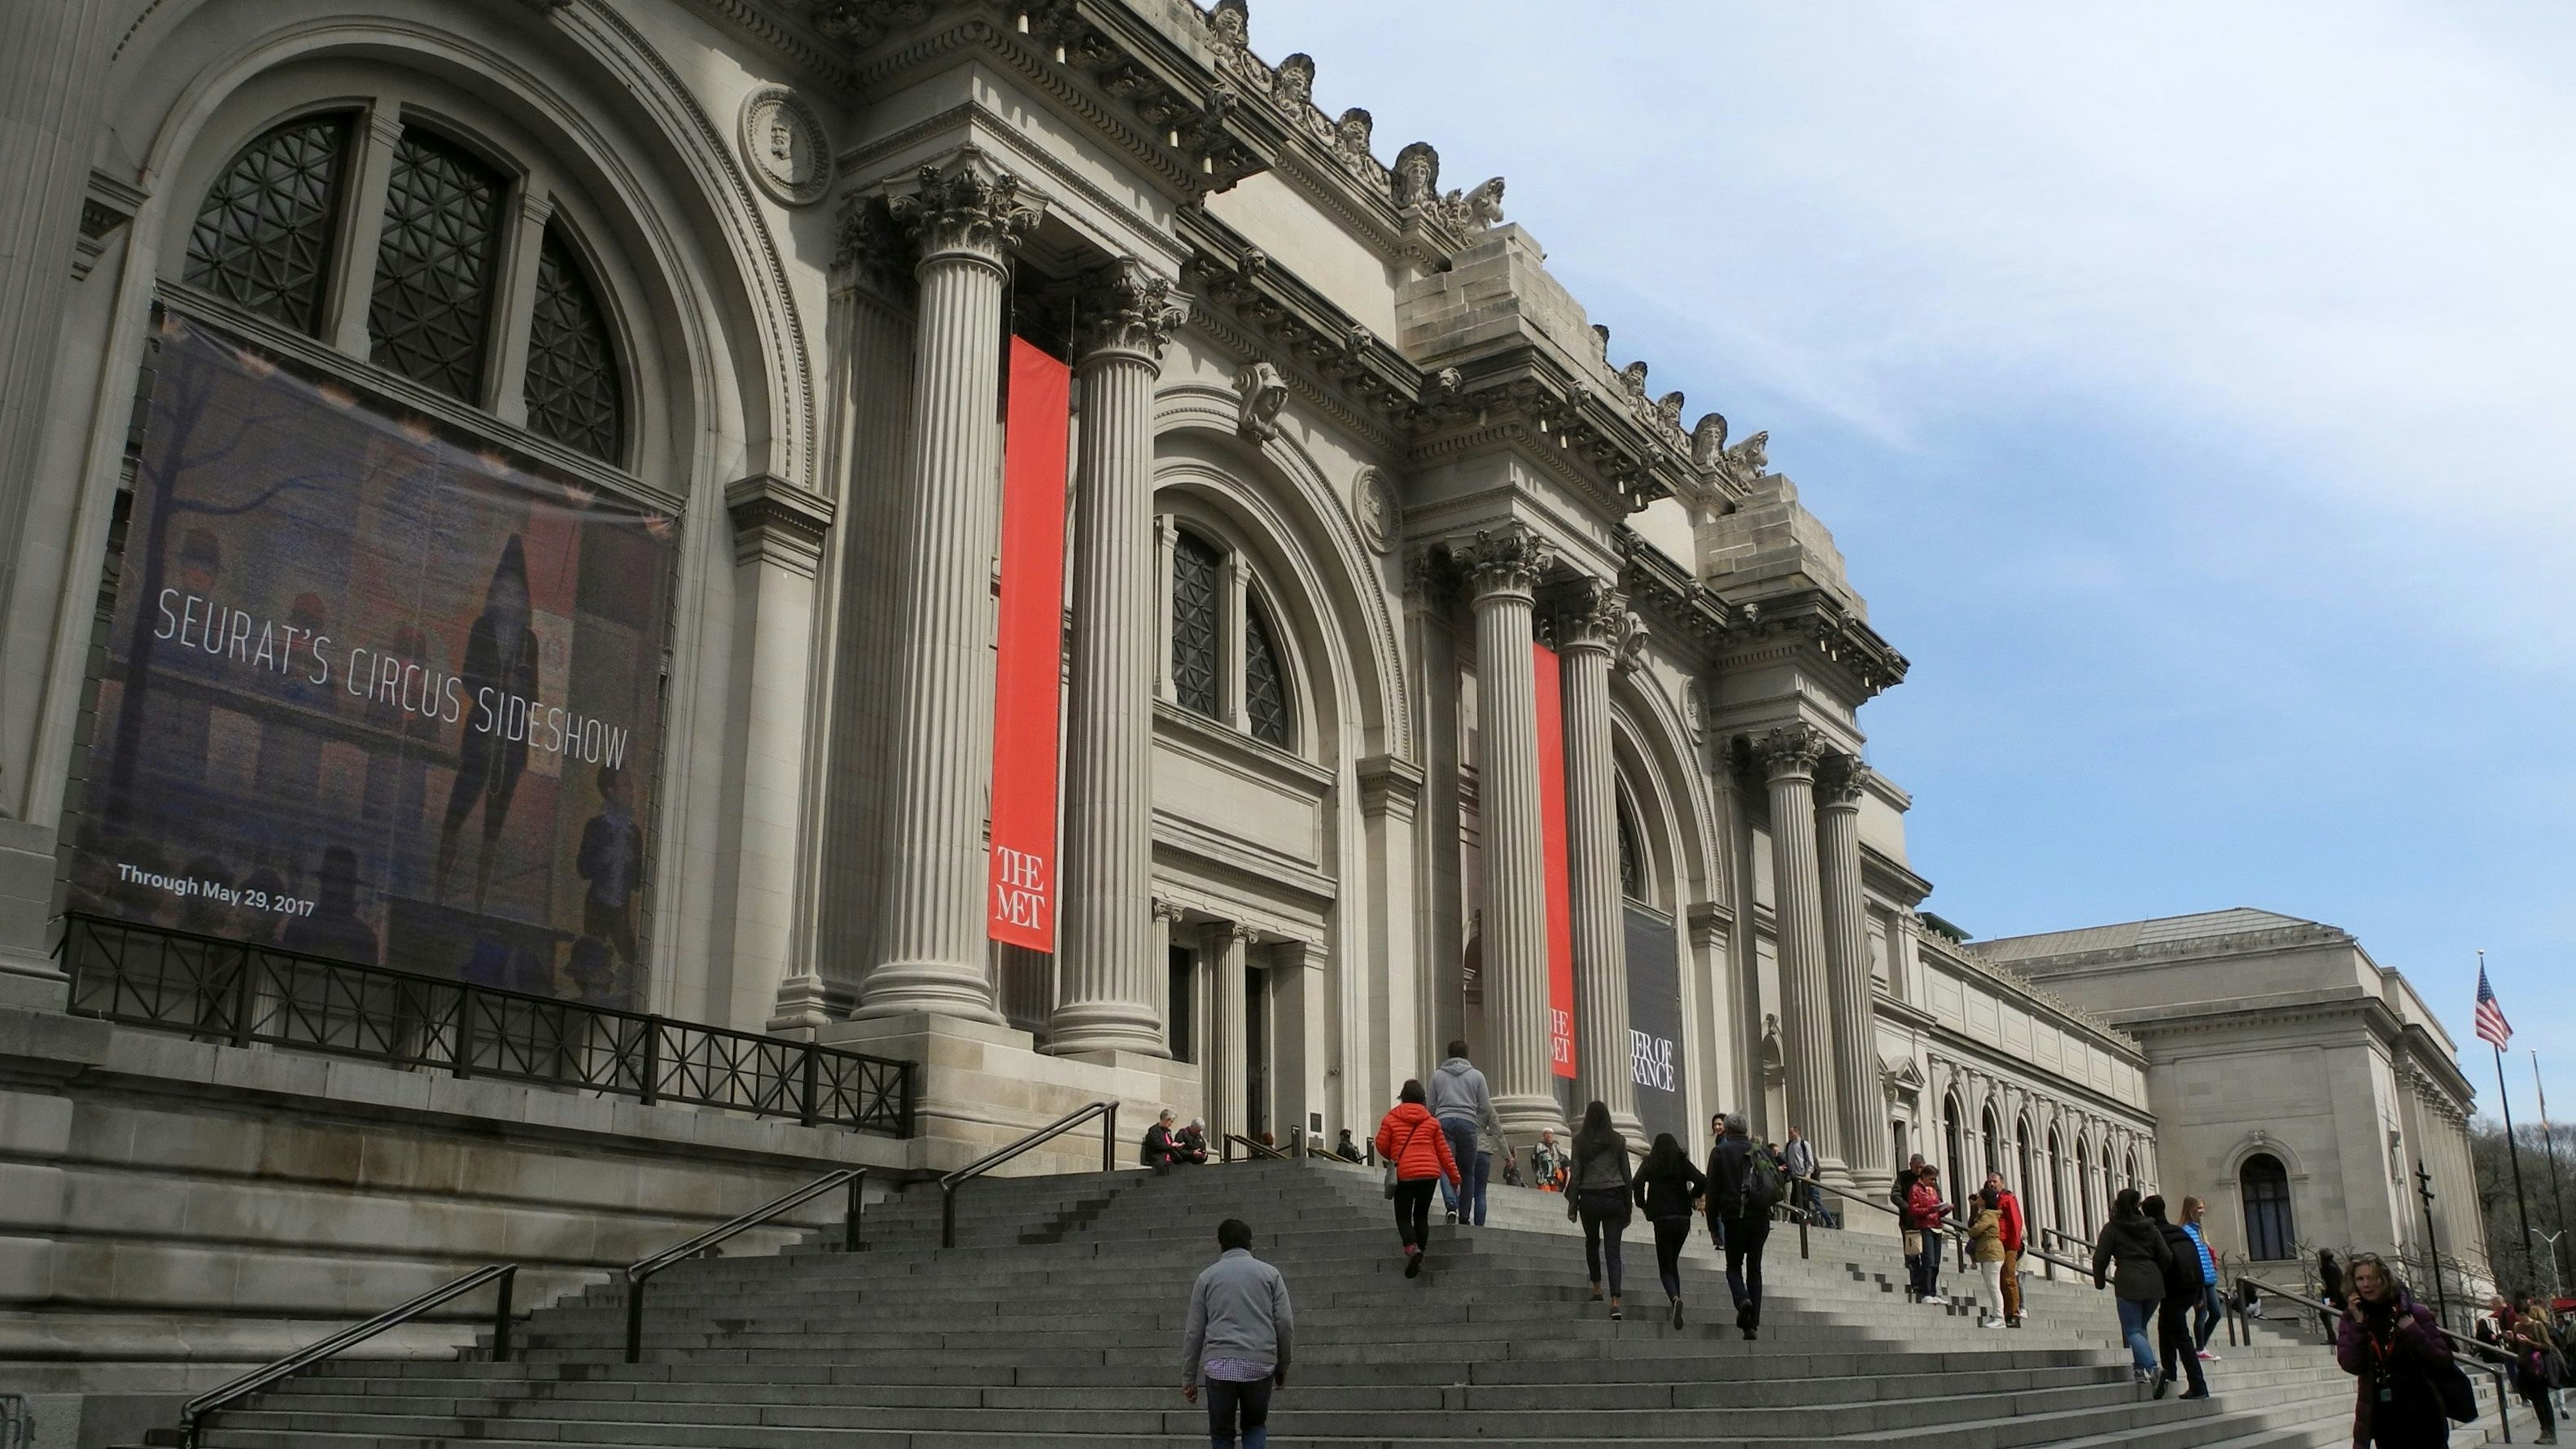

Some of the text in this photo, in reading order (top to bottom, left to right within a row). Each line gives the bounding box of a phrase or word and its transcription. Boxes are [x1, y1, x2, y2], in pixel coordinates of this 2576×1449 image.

[154, 589, 628, 770] SEURAT'S CIRCUS SIDESHOW
[118, 863, 315, 917] Through May 29, 2017
[997, 845, 1044, 891] THE
[995, 883, 1046, 930] MET
[1655, 1037, 1673, 1065] OF
